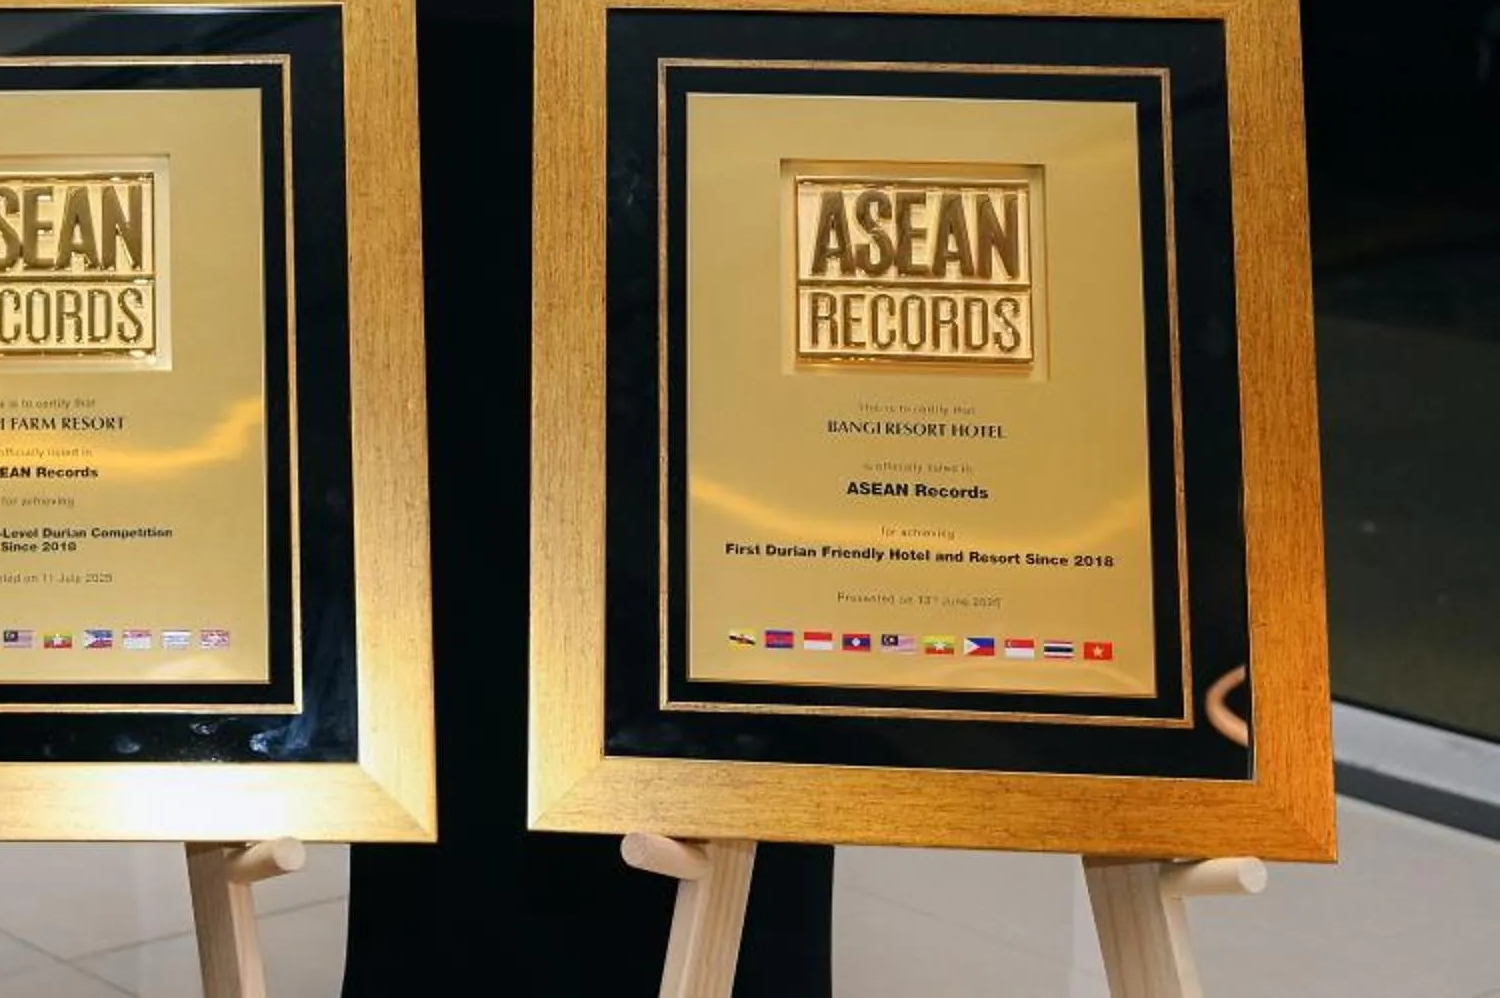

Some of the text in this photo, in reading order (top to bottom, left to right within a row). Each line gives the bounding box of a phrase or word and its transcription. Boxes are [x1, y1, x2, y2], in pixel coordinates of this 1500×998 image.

[811, 190, 1020, 280] ASEAN
[810, 292, 1021, 352] RECORDS
[11, 417, 56, 431] FARM
[62, 417, 125, 431] RESORT
[827, 420, 1007, 439] BANGI RESORT HOTEL
[36, 466, 99, 479] Records
[847, 482, 989, 499] ASEAN Records
[43, 528, 87, 539] Durian
[91, 527, 173, 540] Competition
[1, 542, 77, 552] Since 2018
[725, 543, 1115, 567] First Durian Friendly Hotel and Resort Since 2018
[58, 573, 80, 584] July
[837, 592, 895, 604] Presented
